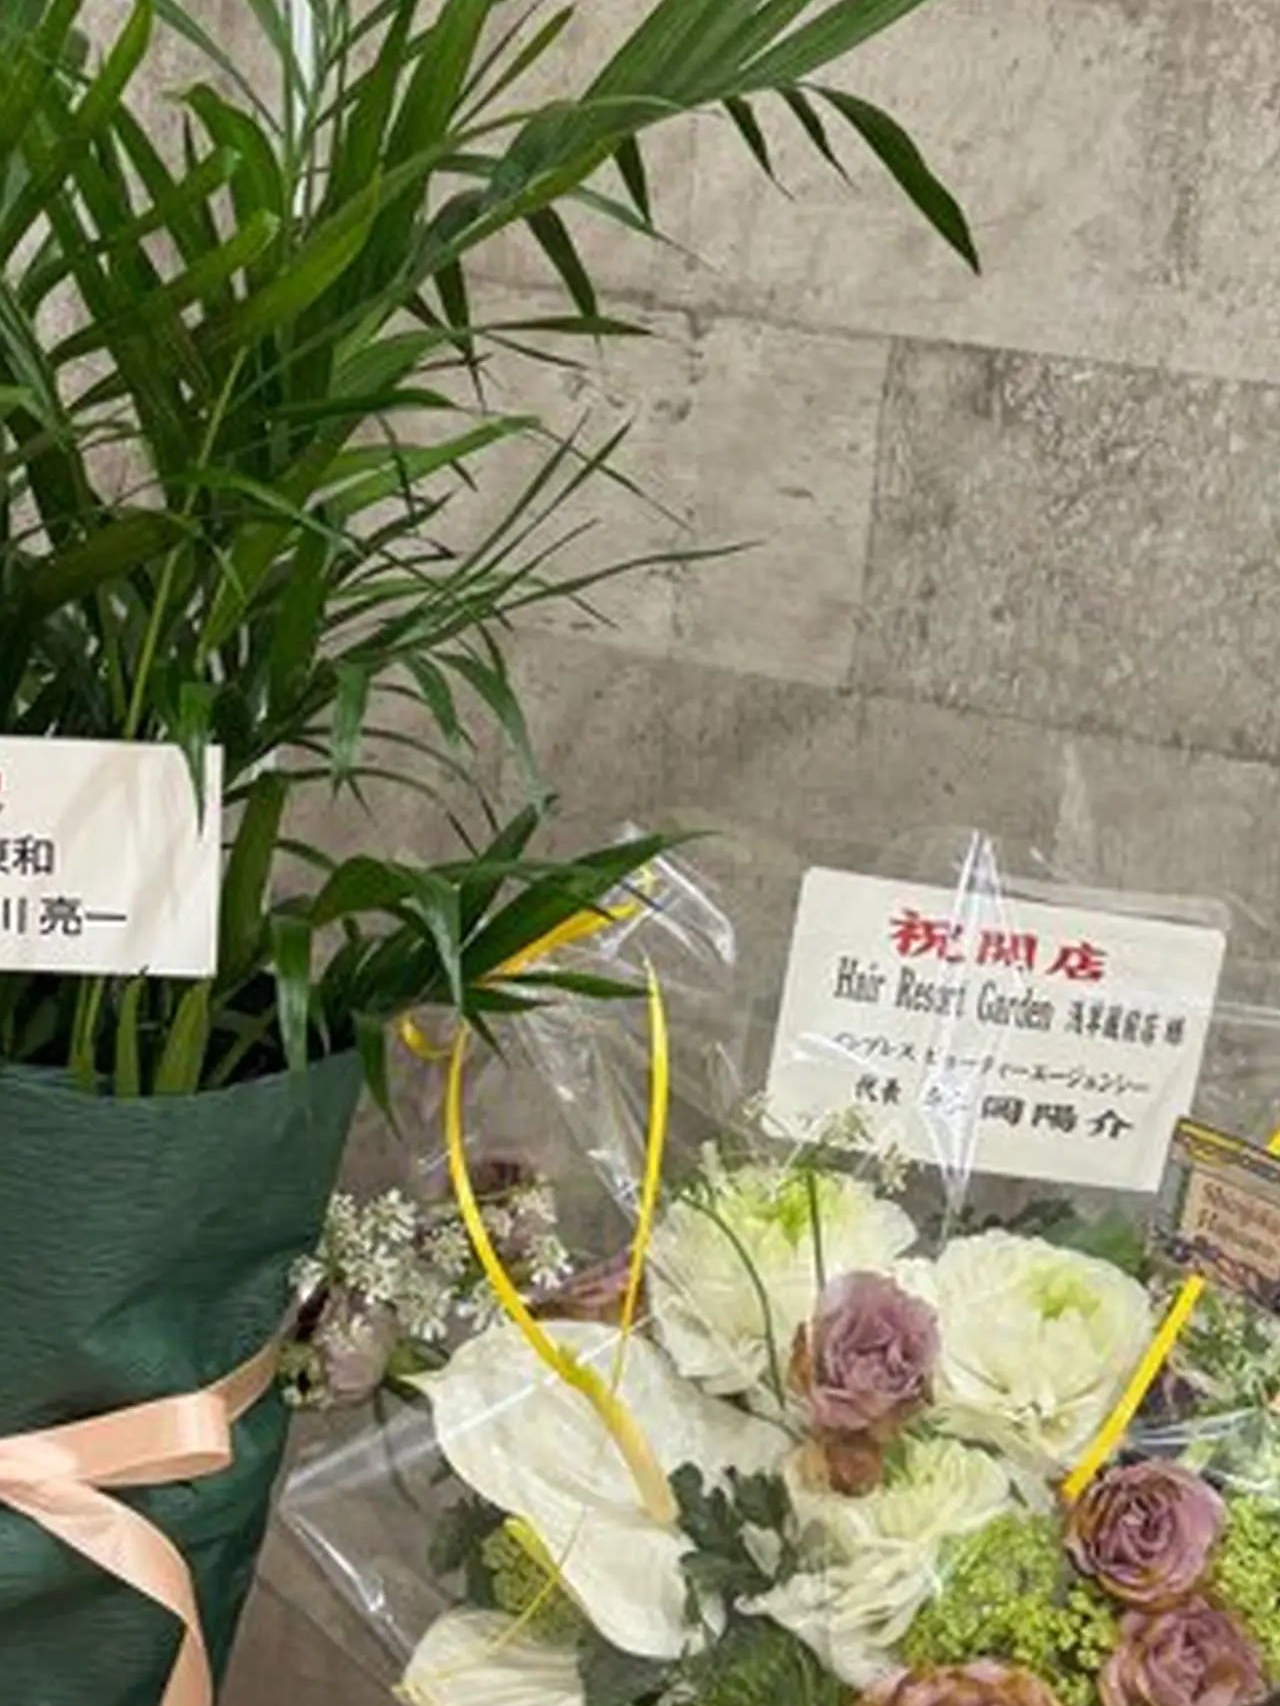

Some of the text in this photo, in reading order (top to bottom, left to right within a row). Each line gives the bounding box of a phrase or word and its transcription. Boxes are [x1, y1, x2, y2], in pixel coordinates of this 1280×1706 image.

[889, 908, 1110, 983] 祝開店
[832, 955, 887, 1004] Hair
[894, 965, 967, 1019] Resort
[976, 981, 1056, 1032] Garden
